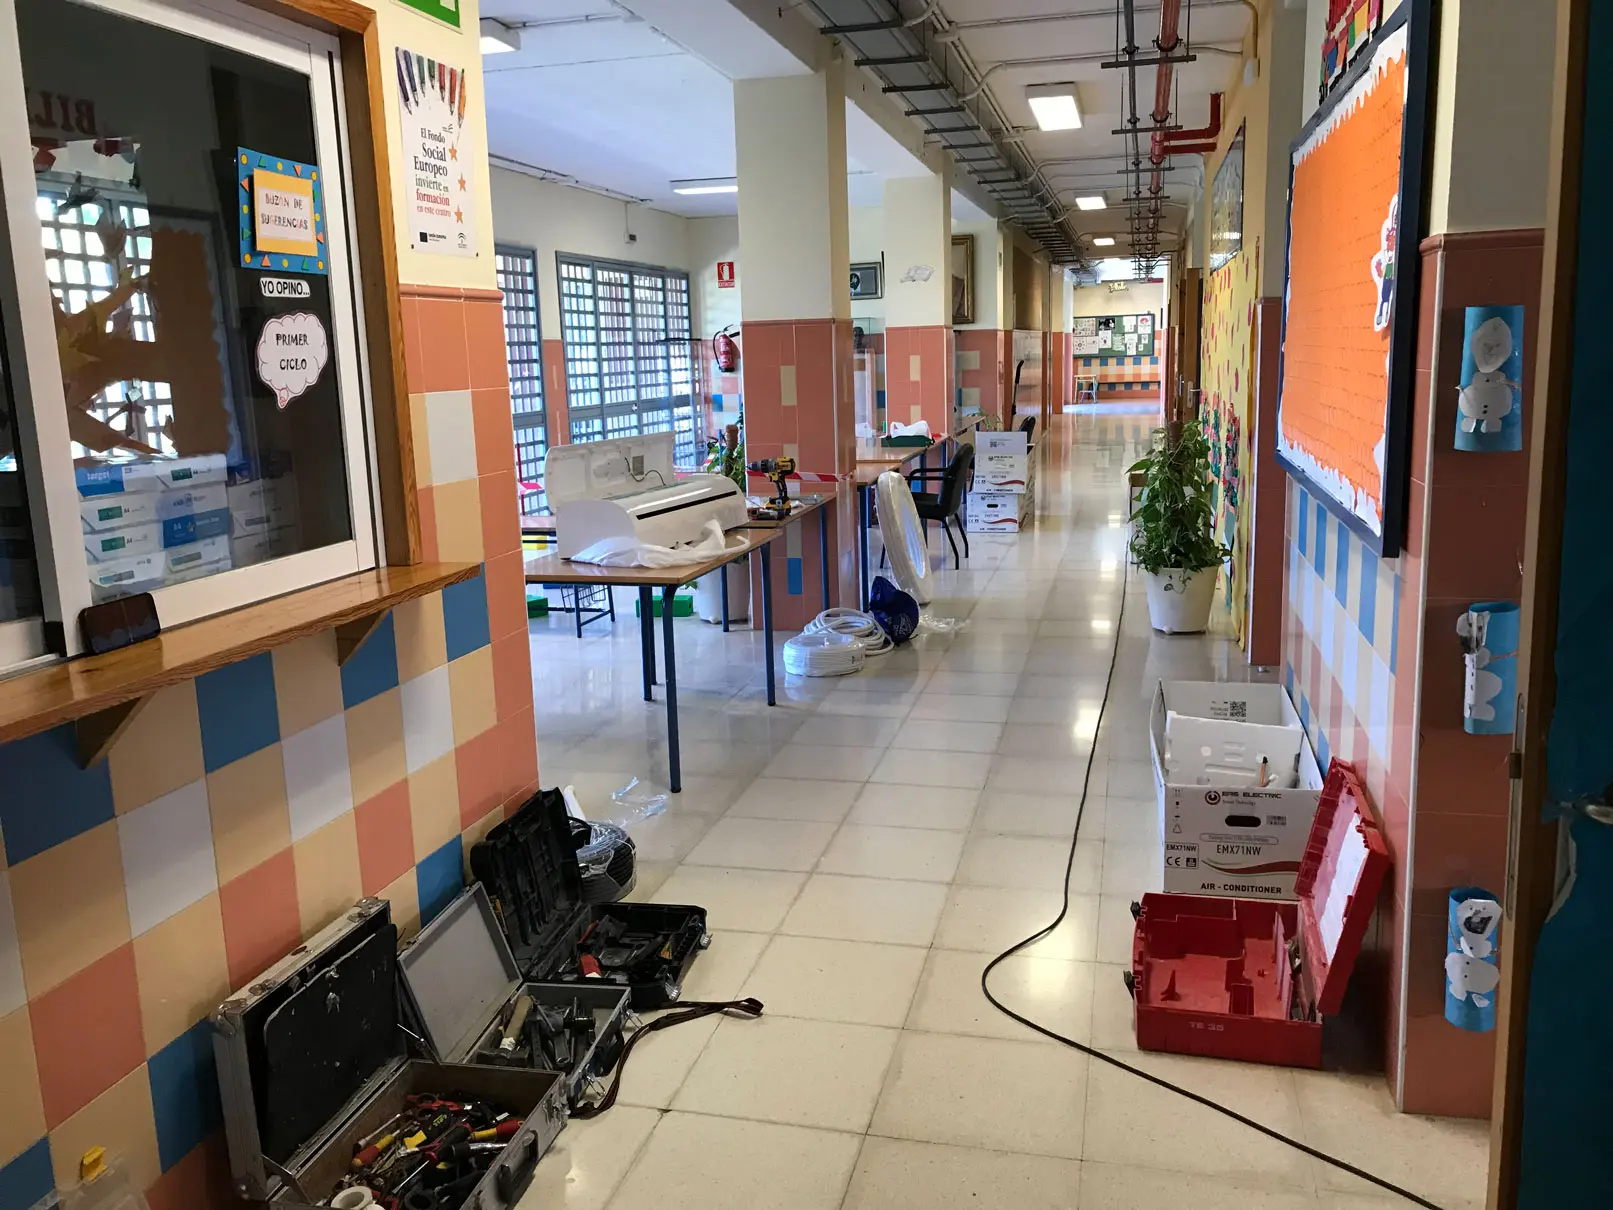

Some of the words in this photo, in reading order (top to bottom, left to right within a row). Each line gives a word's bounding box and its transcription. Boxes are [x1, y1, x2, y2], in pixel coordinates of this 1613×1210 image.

[420, 127, 427, 139] El
[427, 129, 446, 144] Fondo
[422, 142, 446, 162] Social
[413, 155, 448, 179] Europeo
[415, 173, 442, 192] invierte
[416, 188, 450, 206] formación
[293, 198, 303, 210] DE
[416, 205, 423, 213] en
[424, 206, 435, 215] este
[435, 209, 451, 218] centro
[261, 213, 308, 230] SUGERENCIAS
[261, 280, 275, 294] YO
[276, 281, 310, 296] OPINO...
[275, 333, 309, 346] PRIMER
[279, 358, 307, 371] CICLO
[87, 471, 111, 480] target
[1166, 843, 1197, 852] EMX71NW
[1216, 844, 1262, 856] EMX71NW
[1201, 882, 1216, 891] AIR
[1223, 883, 1282, 895] CONDITIONER
